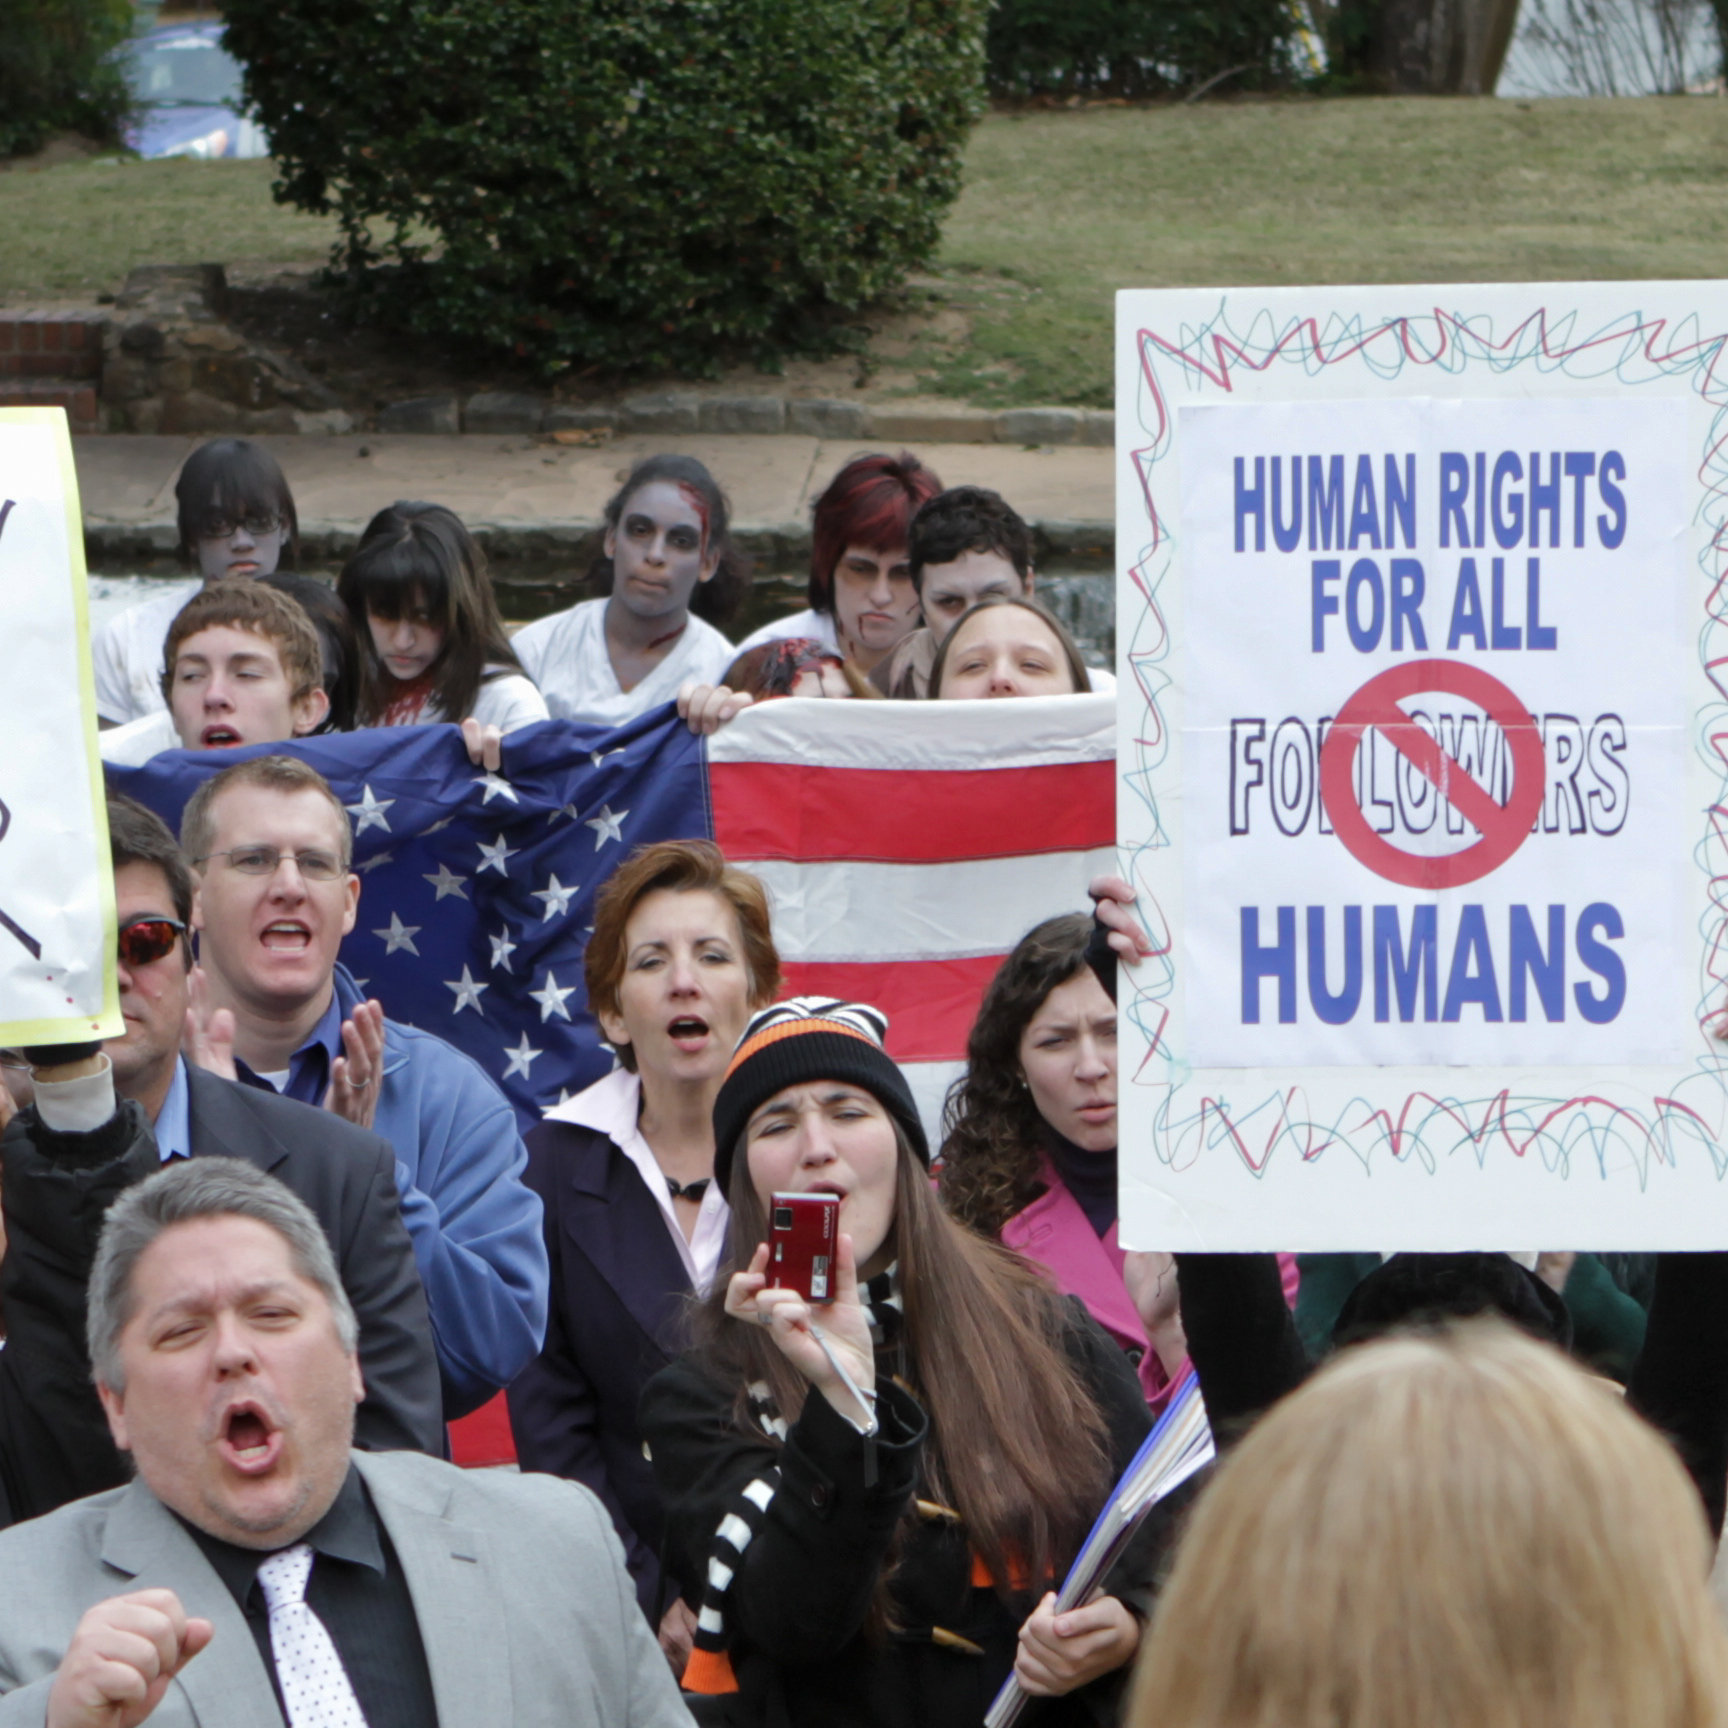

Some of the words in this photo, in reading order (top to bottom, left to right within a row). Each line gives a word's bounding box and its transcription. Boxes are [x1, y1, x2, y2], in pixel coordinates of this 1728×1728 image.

[1233, 453, 1417, 553] HUMAN
[1438, 450, 1627, 551] RIGHTS
[1311, 558, 1427, 653] FOR
[1447, 556, 1558, 650] ALL
[1239, 901, 1628, 1025] HUMANS
